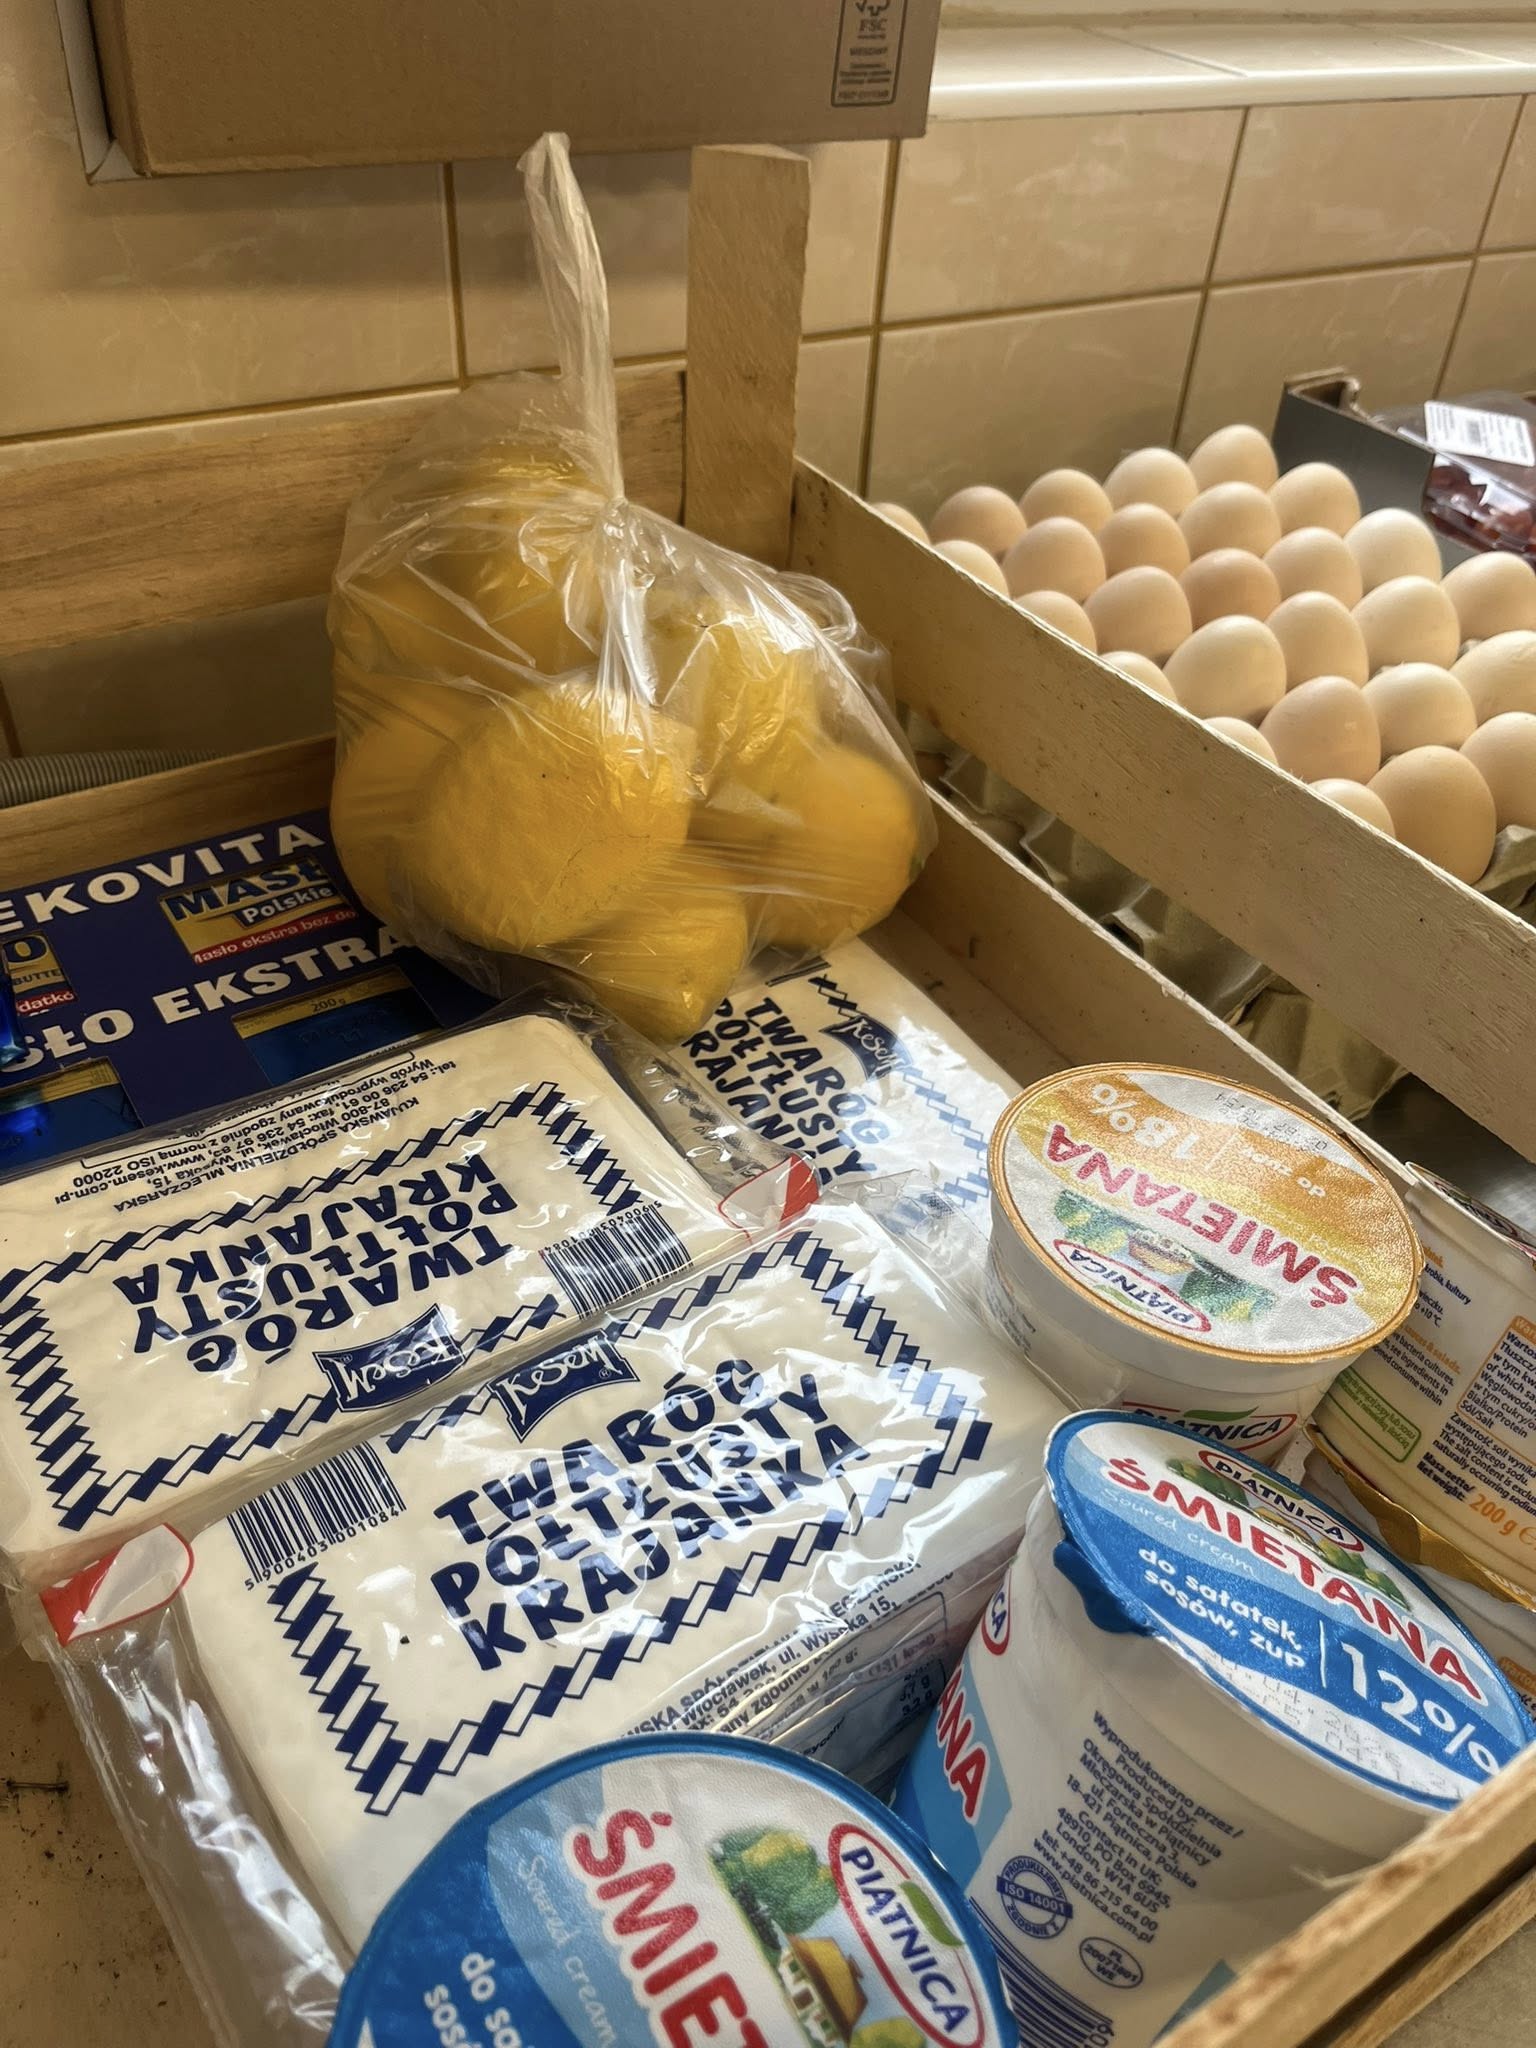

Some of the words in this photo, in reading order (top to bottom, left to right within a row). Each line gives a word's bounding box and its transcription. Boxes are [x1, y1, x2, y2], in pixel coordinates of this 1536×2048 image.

[242, 887, 332, 924] Polskie
[242, 925, 299, 949] ekstra
[361, 1090, 379, 1103] 00
[382, 1079, 408, 1096] 236
[389, 1056, 433, 1081] Wyrób
[410, 1070, 428, 1084] 54
[745, 997, 892, 1145] TWARÓG
[220, 1114, 275, 1143] zgodnie
[257, 1125, 284, 1141] 236
[285, 1117, 305, 1130] 54
[306, 1107, 332, 1122] fax:
[335, 1096, 359, 1112] 61,
[337, 1096, 419, 1135] KUJAWSKA
[340, 1097, 390, 1121] 87-800
[1091, 1083, 1200, 1160] 18%
[125, 1155, 155, 1171] ISO
[158, 1141, 205, 1160] normą
[208, 1137, 217, 1146] z
[226, 1128, 337, 1174] SPÓŁDZIELNIA
[235, 1146, 254, 1158] ul.
[72, 1164, 123, 1187] 22000
[113, 1164, 225, 1213] MLECZARSKA
[146, 1173, 170, 1189] 15,
[113, 1154, 499, 1305] KRAJANKA
[1046, 1124, 1360, 1309] ŚMIETANA
[133, 1182, 518, 1354] PÓŁTŁUSTY
[1070, 1249, 1194, 1327] PIĄTNICA
[186, 1223, 515, 1373] TWARÓG
[1398, 1352, 1441, 1391] ingredients
[1485, 1361, 1498, 1373] of
[1495, 1368, 1525, 1394] which
[1500, 1358, 1521, 1376] tym
[1481, 1387, 1501, 1406] tym
[433, 1359, 765, 1545] TWARÓG
[1422, 1451, 1446, 1474] Masa
[1438, 1429, 1456, 1446] The
[1454, 1441, 1472, 1458] salt
[1469, 1453, 1505, 1482] content
[1503, 1476, 1513, 1487] is
[1442, 1422, 1507, 1471] występującego
[1505, 1465, 1529, 1486] sodu.
[1449, 1411, 1495, 1448] Zawartość
[1491, 1441, 1510, 1459] soli
[431, 1373, 829, 1617] PÓŁTŁUSTY
[1431, 1439, 1469, 1472] naturally
[1467, 1466, 1509, 1499] occurring
[1214, 1462, 1346, 1541] PIĄTNICA
[1416, 1460, 1434, 1478] Net
[1468, 1491, 1507, 1526] 200
[1498, 1517, 1518, 1538] g
[459, 1424, 871, 1671] KRAJANKA
[1104, 1457, 1482, 1701] ŚMIETANA
[1138, 1546, 1177, 1577] do
[1185, 1575, 1304, 1651] sałatek,
[1144, 1569, 1240, 1638] sosów,
[1250, 1633, 1307, 1669] zup
[776, 1643, 801, 1666] ul.
[1341, 1640, 1501, 1777] 12%
[1080, 1737, 1144, 1800] Okręgowa
[1140, 1792, 1223, 1858] Spółdzielnia
[1089, 1710, 1196, 1809] Wyprodukowano
[1193, 1804, 1235, 1836] przez
[1114, 1753, 1176, 1810] Produced
[1173, 1804, 1198, 1829] by:
[1064, 1773, 1102, 1814] 18-421
[1100, 1811, 1154, 1861] Piątnica,
[1155, 1854, 1199, 1889] Polska
[1078, 1752, 1145, 1819] Mleczarska
[1143, 1817, 1157, 1829] w
[1158, 1822, 1212, 1868] Piątnicy
[1089, 1783, 1106, 1801] ul.
[1105, 1796, 1168, 1854] Forteczna
[1055, 1805, 1094, 1847] 48910,
[1092, 1841, 1114, 1863] PO
[1112, 1858, 1137, 1883] Box
[1136, 1877, 1172, 1909] 6945,
[1055, 1821, 1104, 1873] London,
[1102, 1866, 1133, 1895] W1A
[1131, 1889, 1160, 1915] 6US
[1075, 1809, 1125, 1857] Contact
[1123, 1853, 1138, 1869] in
[1138, 1863, 1163, 1887] UK:
[1004, 1882, 1036, 1904] ISO
[1036, 1889, 1068, 1914] 14001
[1030, 1837, 1154, 1945] www.piatnica.com.pl
[1057, 1849, 1084, 1874] +48
[1081, 1870, 1100, 1889] 86
[1098, 1884, 1122, 1907] 215
[1121, 1902, 1140, 1920] 64
[1139, 1914, 1159, 1933] 00
[841, 1846, 971, 2034] PIĄTNICA
[461, 1952, 496, 2002] do
